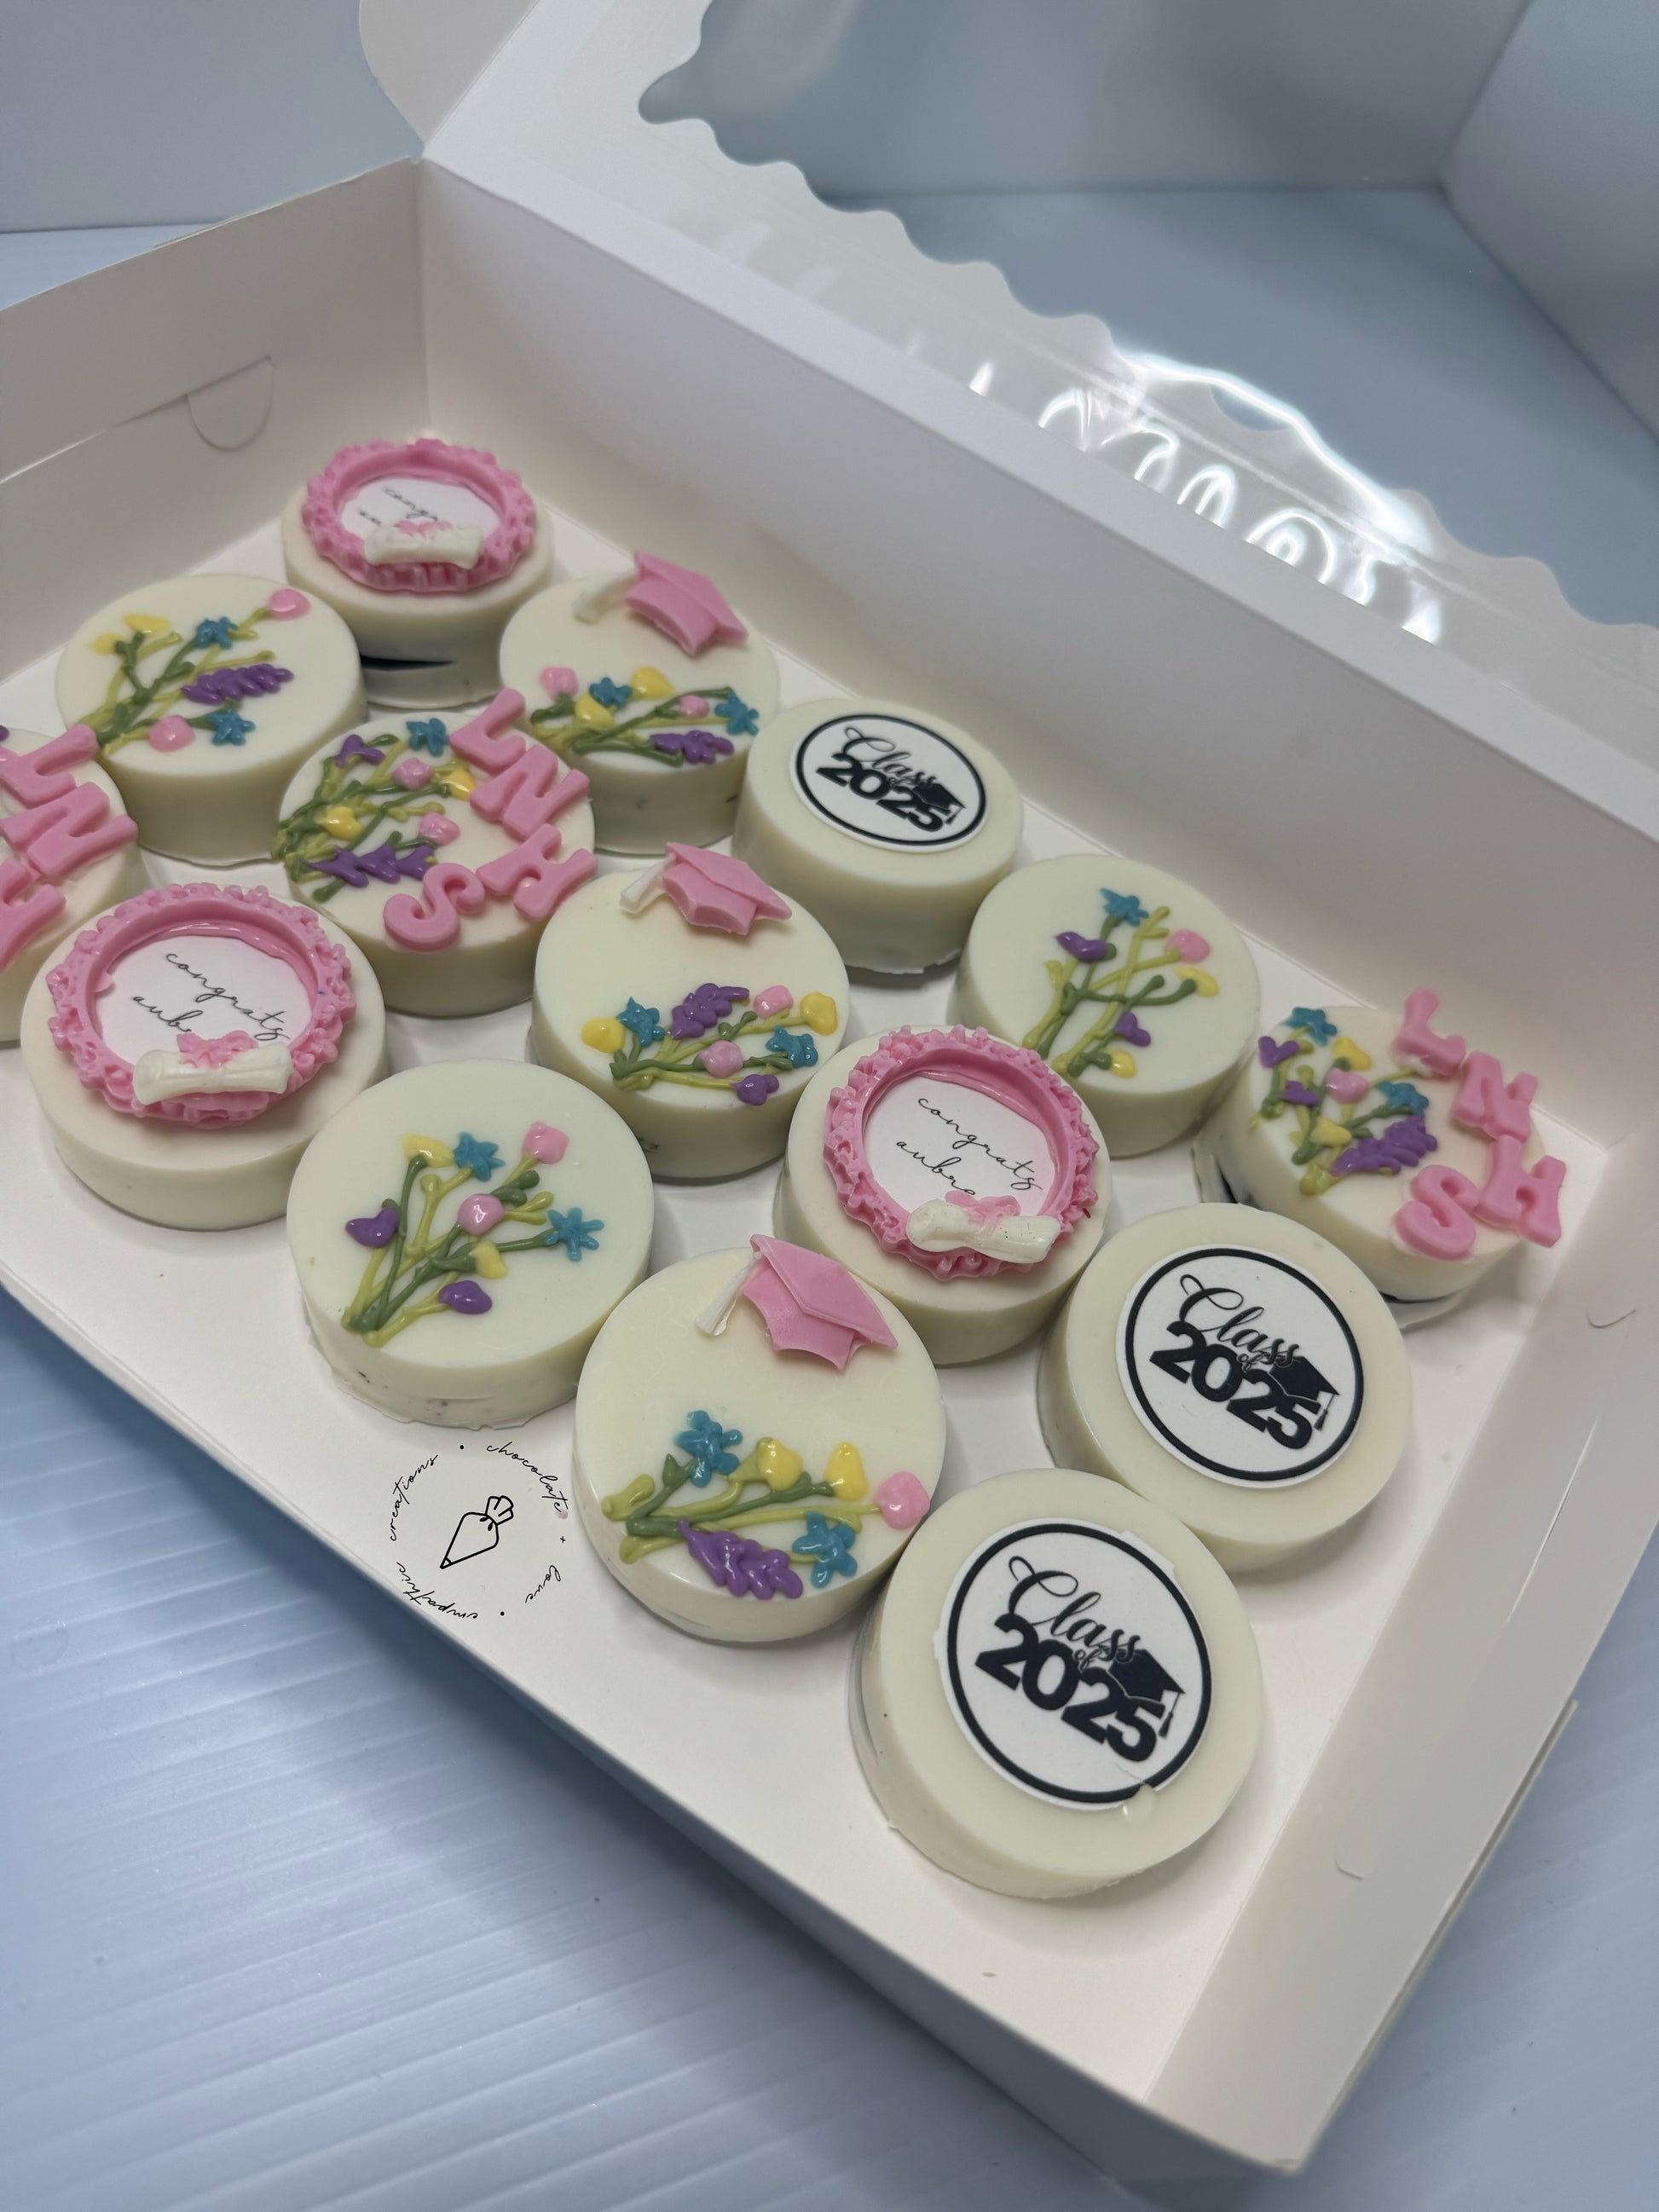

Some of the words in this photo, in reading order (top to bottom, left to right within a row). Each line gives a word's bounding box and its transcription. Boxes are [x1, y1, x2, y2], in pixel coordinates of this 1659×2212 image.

[384, 488, 438, 522] congr
[816, 752, 952, 833] 2025
[842, 726, 938, 788] Class
[383, 687, 598, 953] LNHS
[165, 953, 292, 1042] congrats
[917, 1097, 1043, 1191] congrats
[1391, 987, 1567, 1262] LNHS
[1178, 1273, 1300, 1366] Class
[1237, 1352, 1265, 1372] of
[1148, 1320, 1322, 1450] 2025
[1008, 1555, 1142, 1662] Class
[974, 1612, 1166, 1763] 2025
[1071, 1648, 1103, 1672] of
